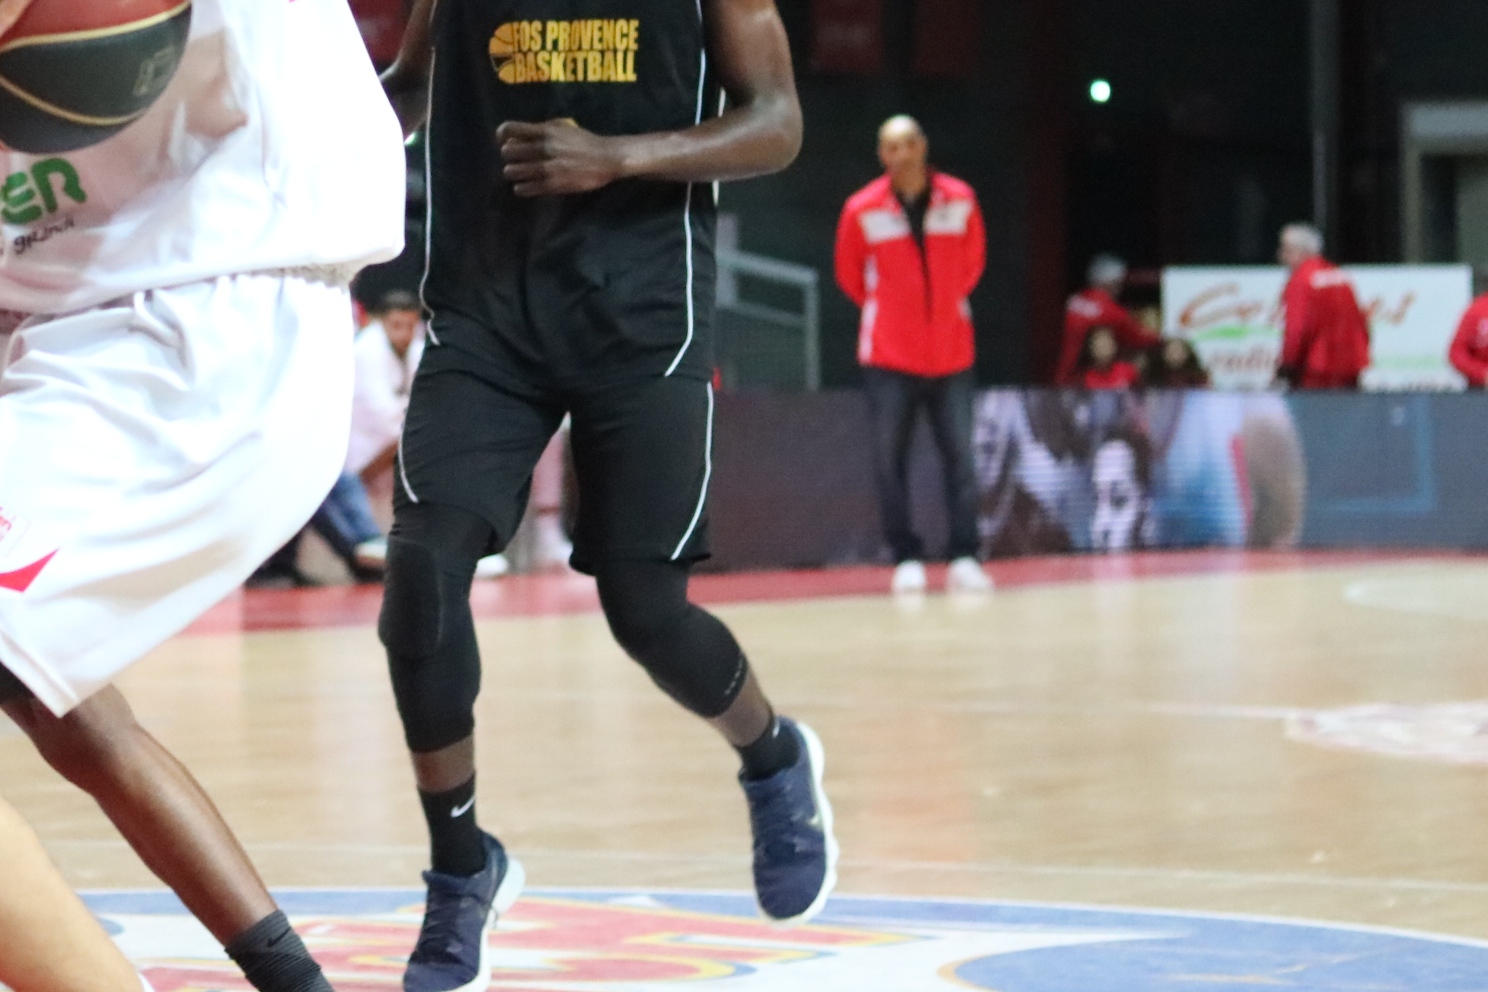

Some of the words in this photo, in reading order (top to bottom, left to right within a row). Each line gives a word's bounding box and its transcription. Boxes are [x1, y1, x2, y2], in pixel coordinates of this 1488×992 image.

[512, 20, 542, 50] FOS
[546, 19, 640, 51] PROVENCE
[513, 51, 638, 84] BASKETBALL
